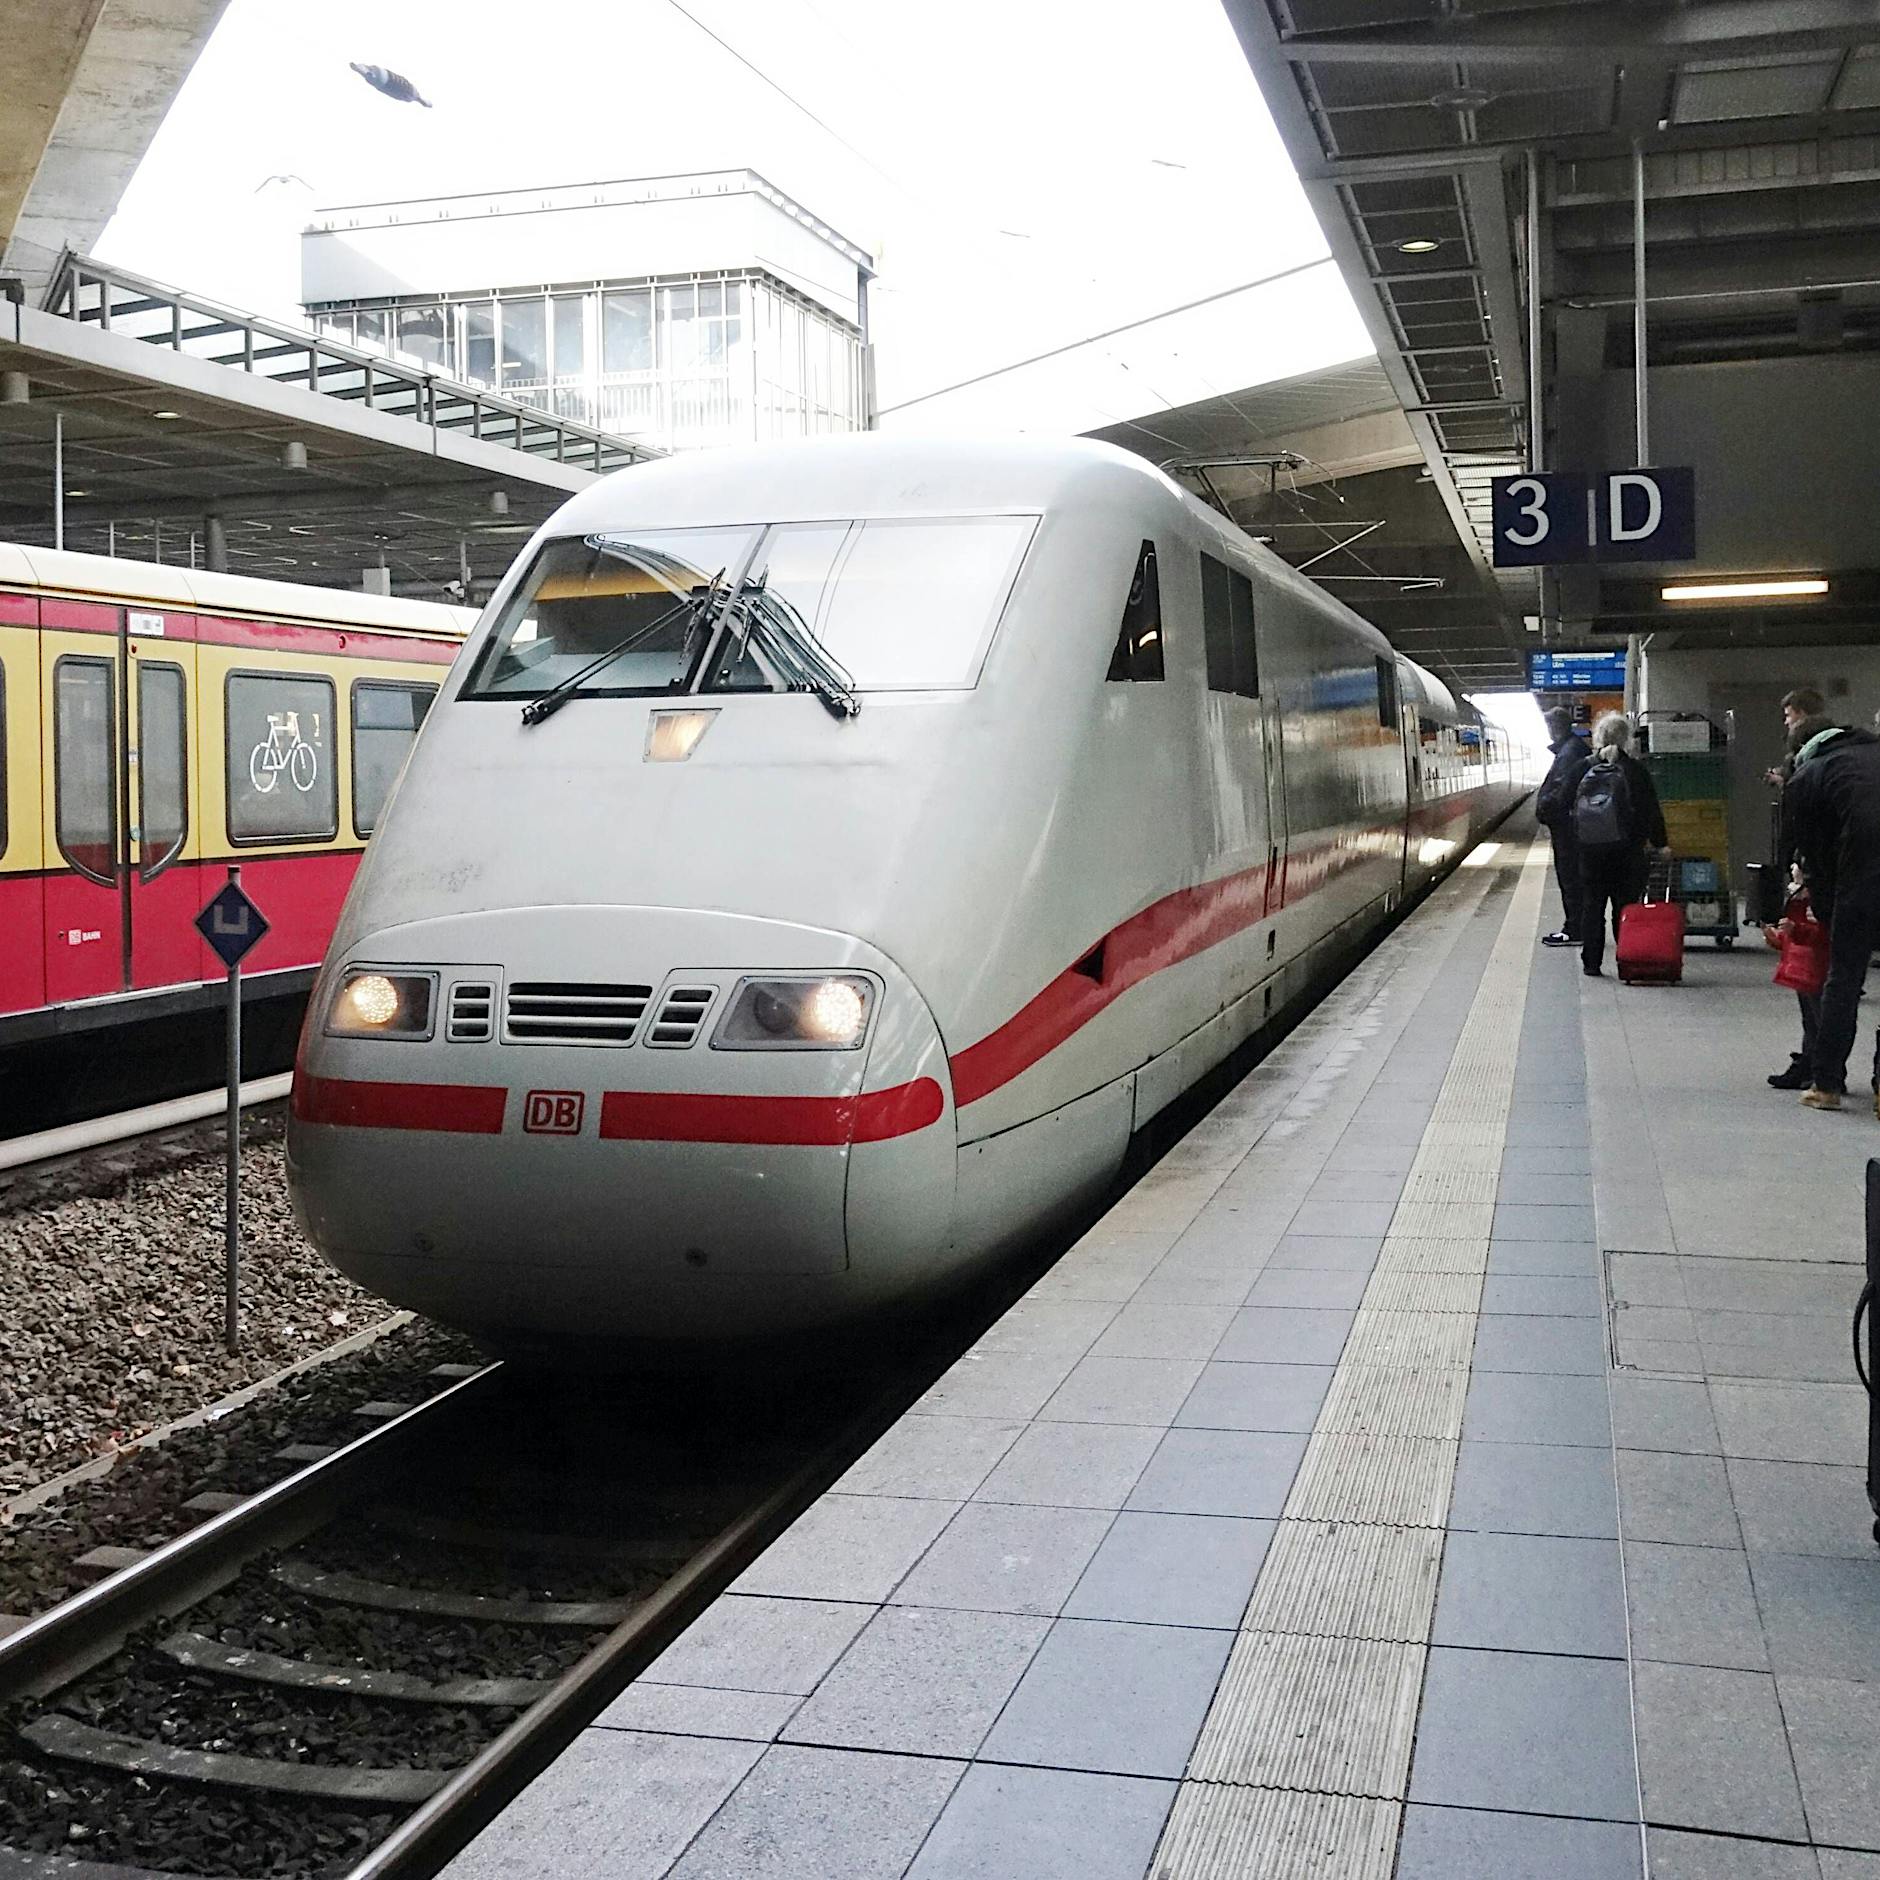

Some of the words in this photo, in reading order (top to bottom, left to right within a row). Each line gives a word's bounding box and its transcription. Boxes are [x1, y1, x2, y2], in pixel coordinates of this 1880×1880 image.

[1504, 478, 1550, 546] 3
[1609, 474, 1662, 542] D
[530, 1097, 576, 1127] DB
